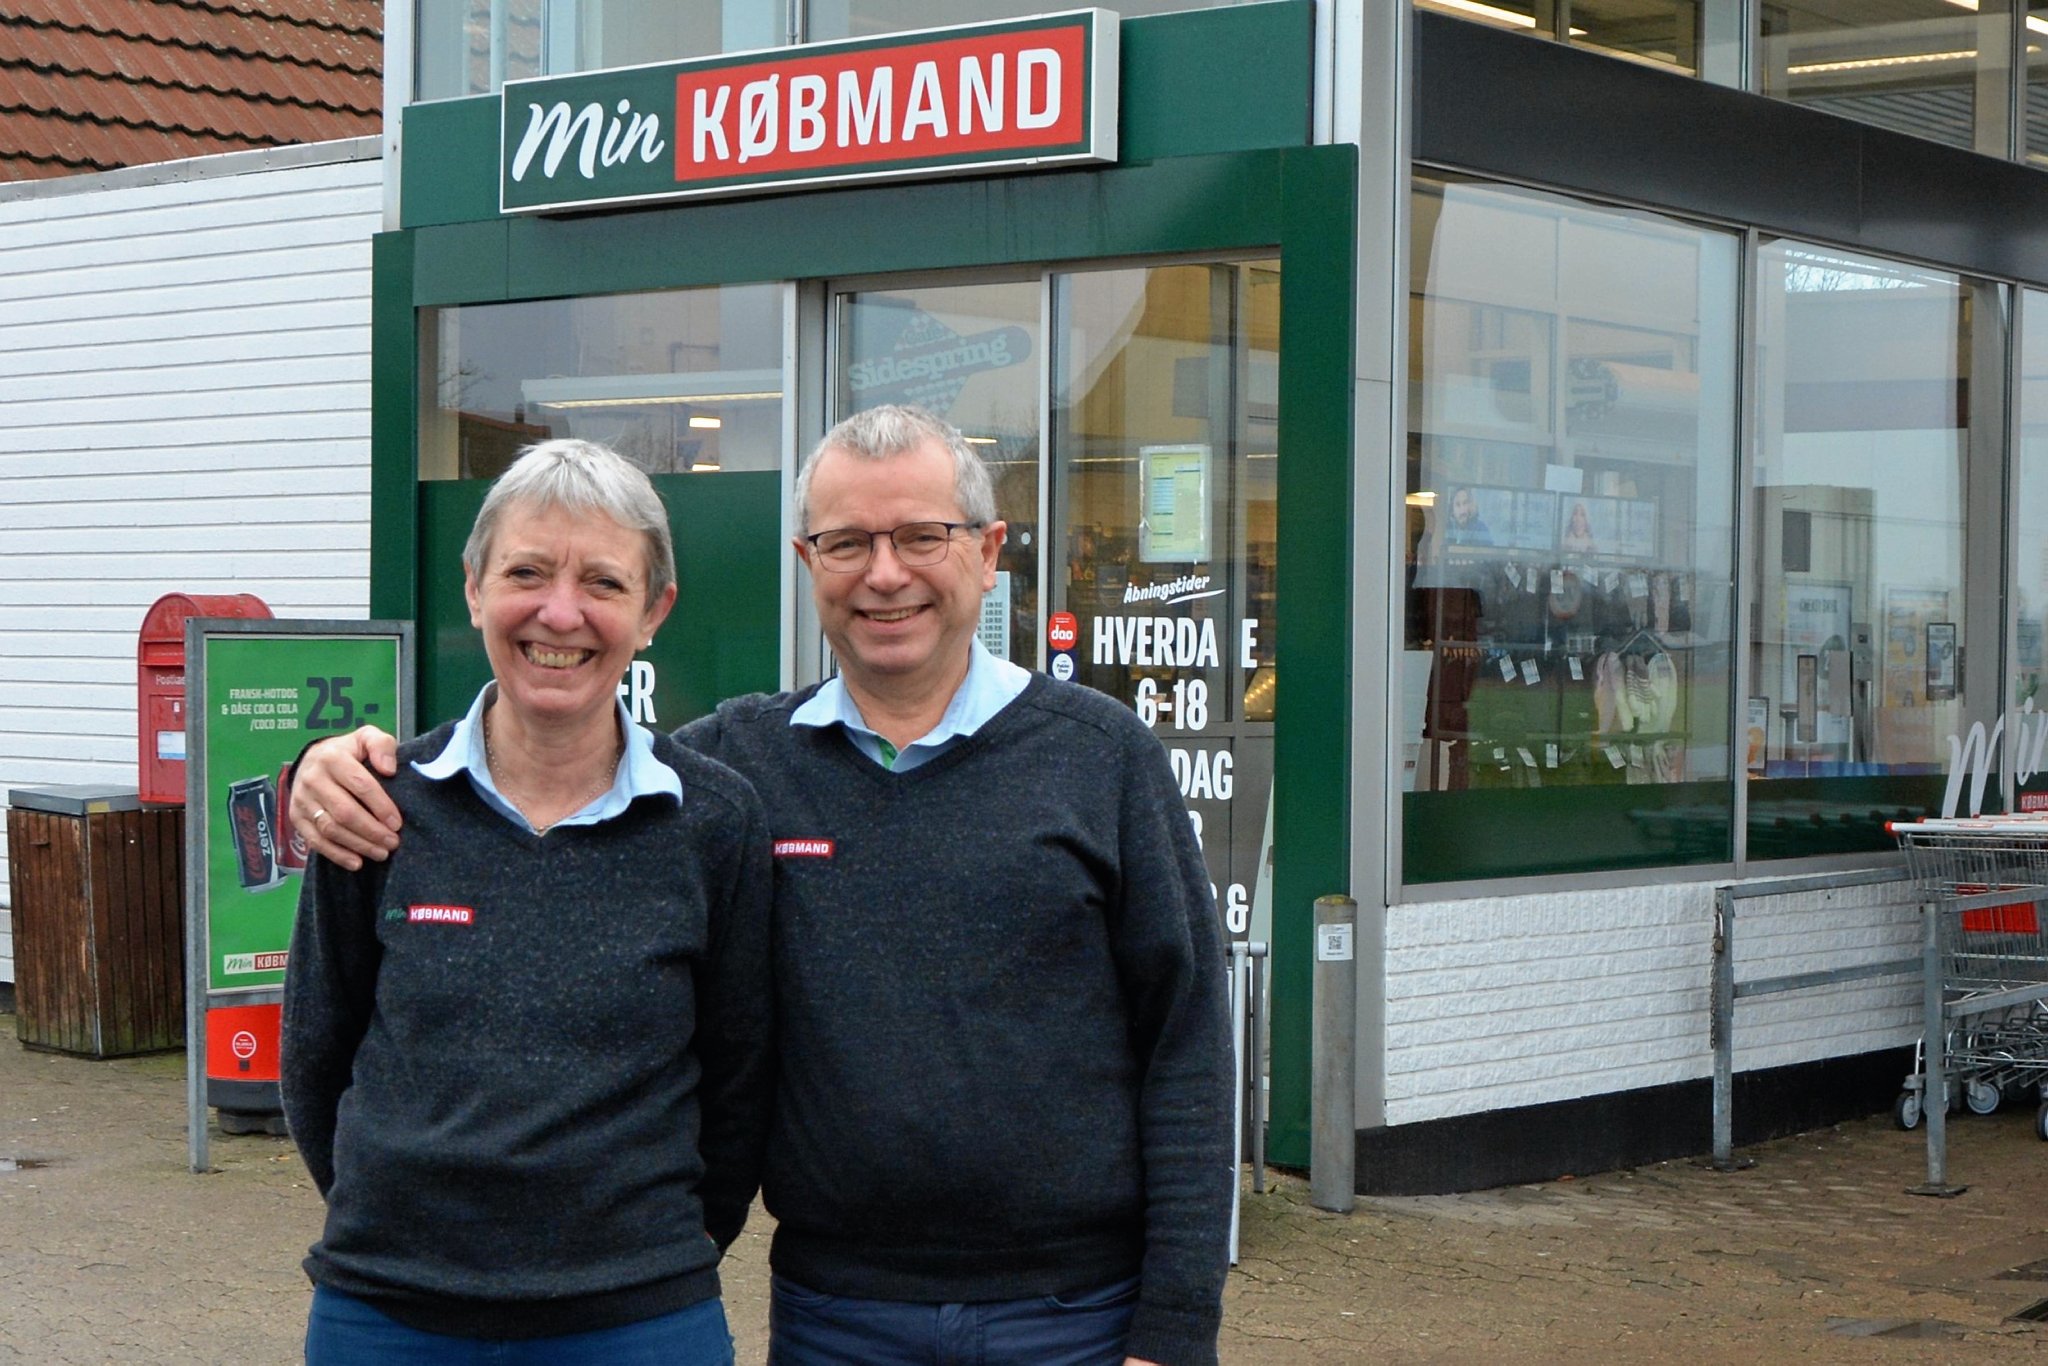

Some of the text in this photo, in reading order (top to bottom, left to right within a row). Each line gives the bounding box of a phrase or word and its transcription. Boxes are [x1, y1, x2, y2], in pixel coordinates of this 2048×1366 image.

[511, 47, 1062, 182] Min KØBMAND
[1123, 574, 1211, 604] Åbningstider
[1051, 624, 1074, 640] dao
[277, 703, 298, 714] COLA
[1136, 677, 1208, 731] 6-18
[774, 842, 829, 855] KØBMAND
[410, 907, 469, 922] KØBMAND
[1226, 883, 1249, 933] &
